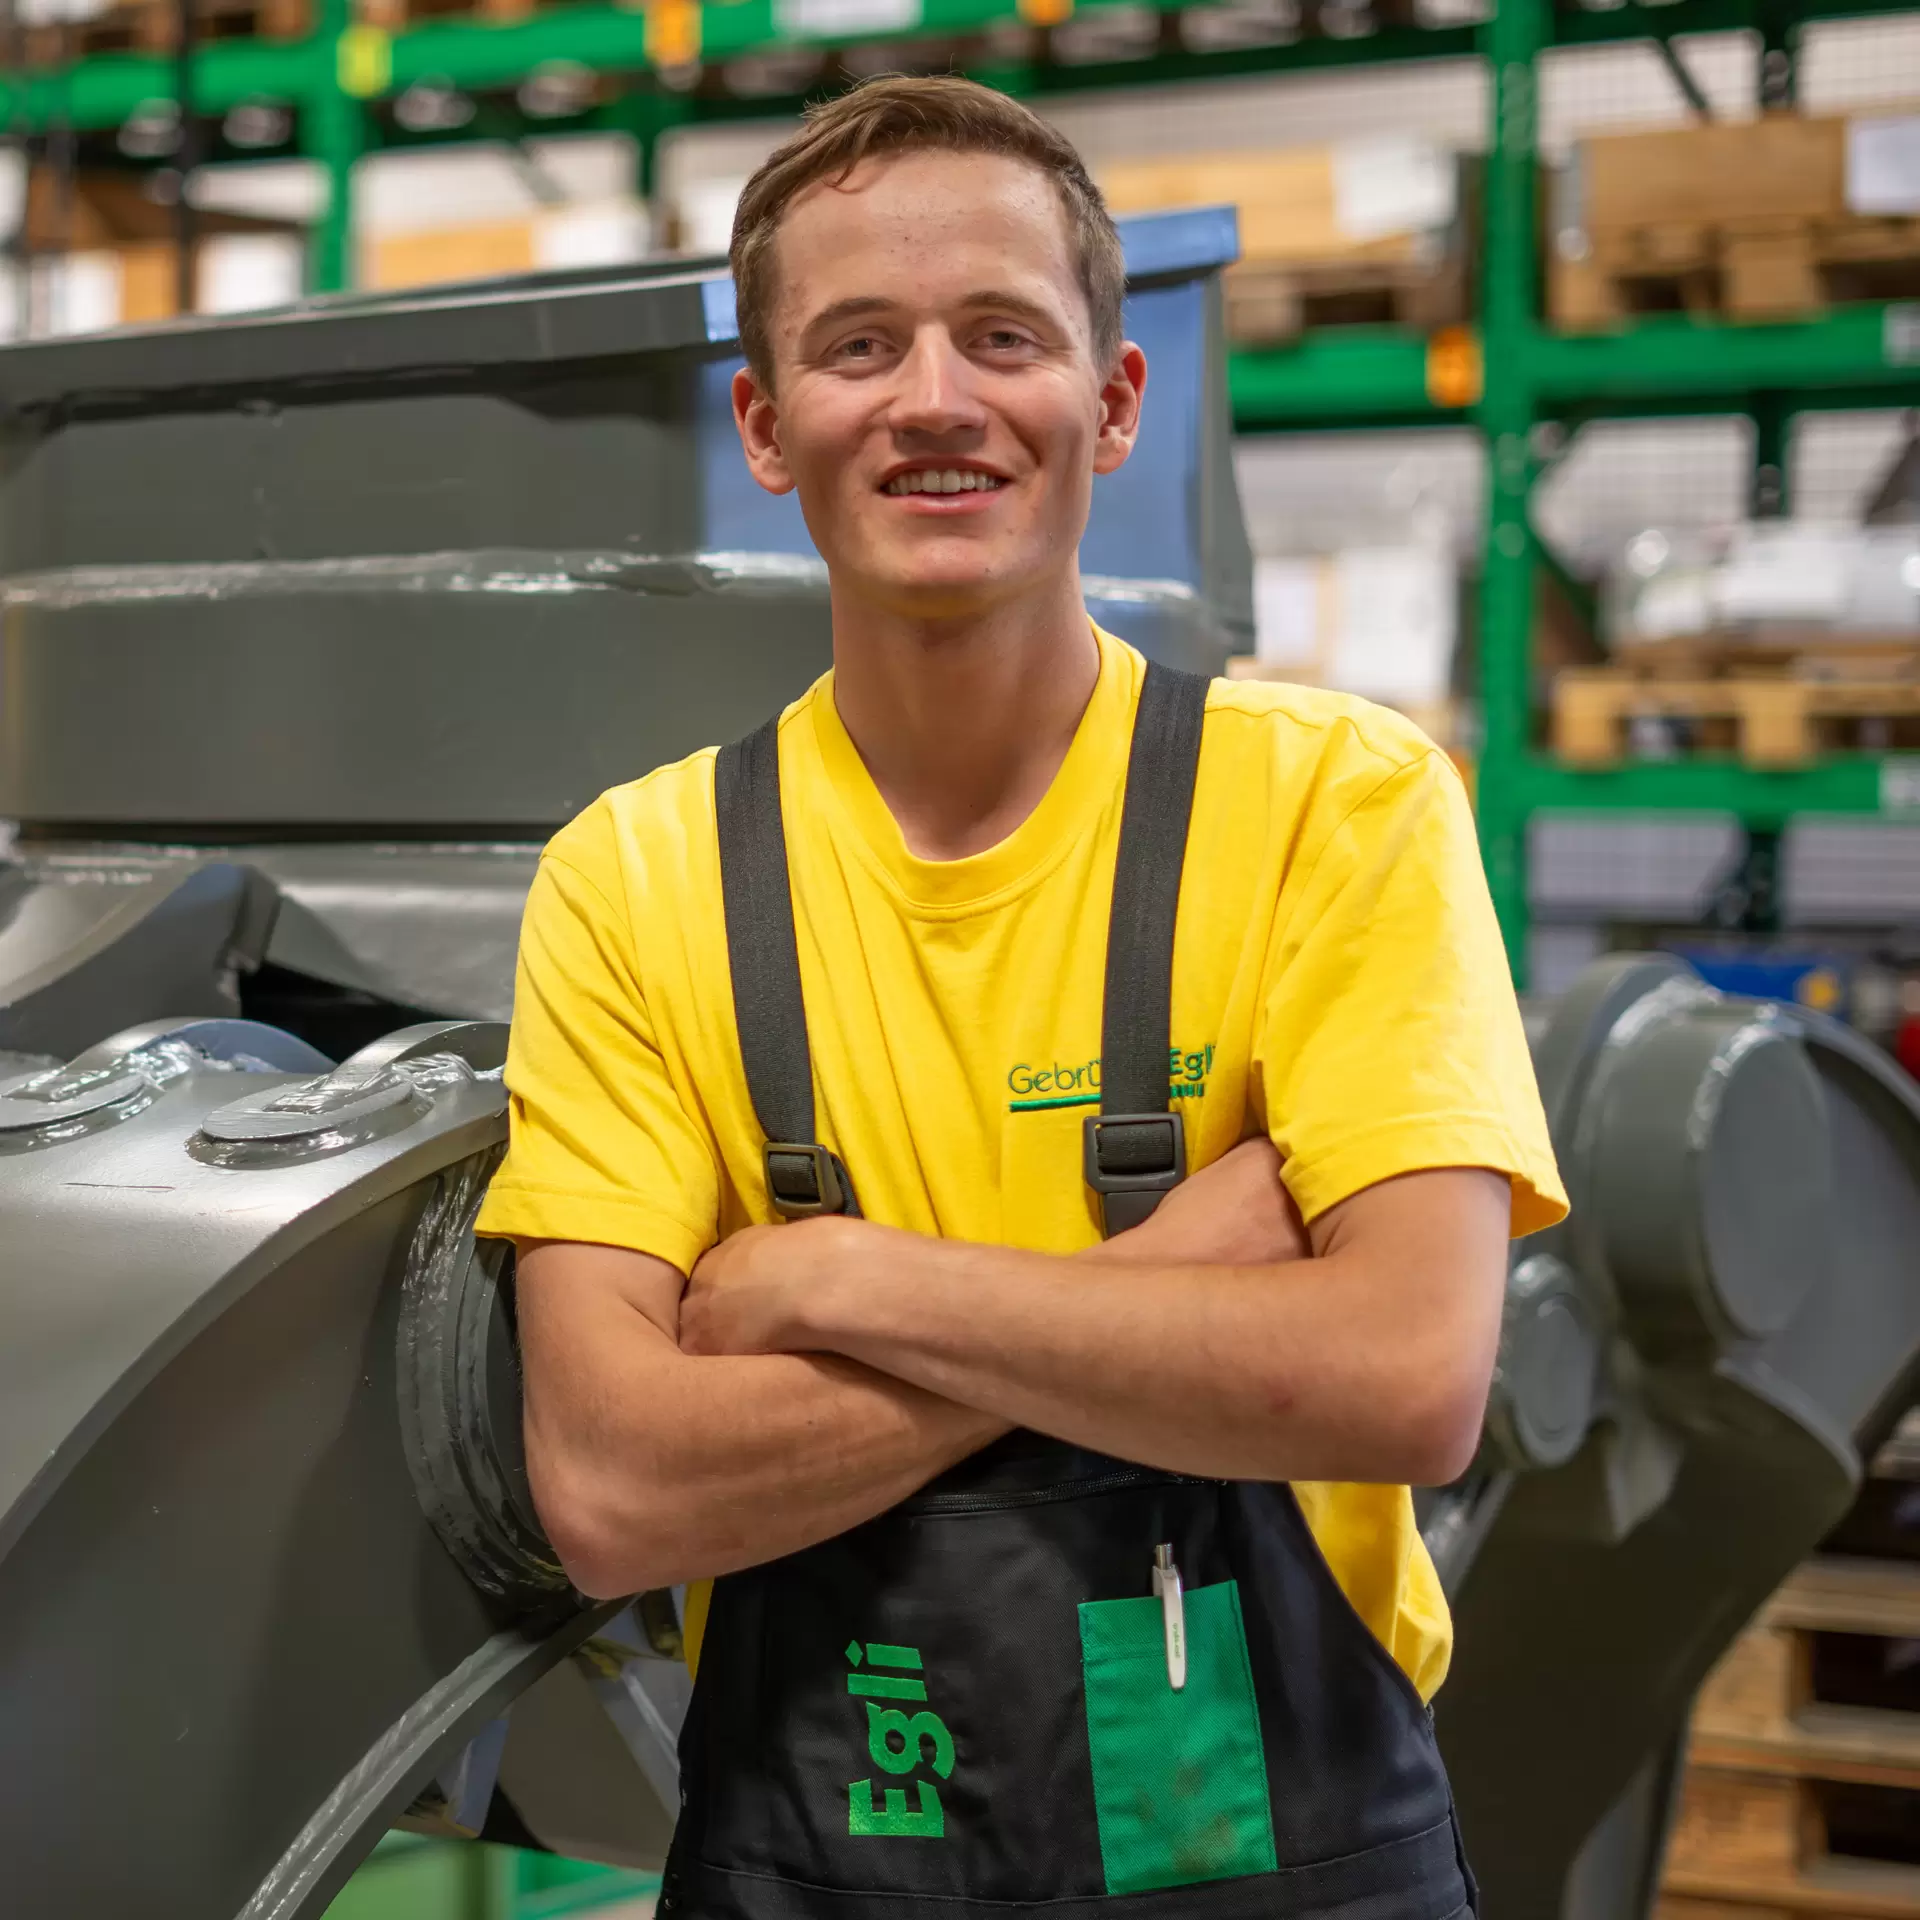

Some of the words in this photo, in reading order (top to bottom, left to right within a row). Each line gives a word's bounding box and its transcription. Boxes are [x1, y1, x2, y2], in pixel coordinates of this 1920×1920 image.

[1008, 1058, 1101, 1094] Gebrü
[1169, 1043, 1216, 1081] Egl
[845, 1639, 955, 1837] Egli
